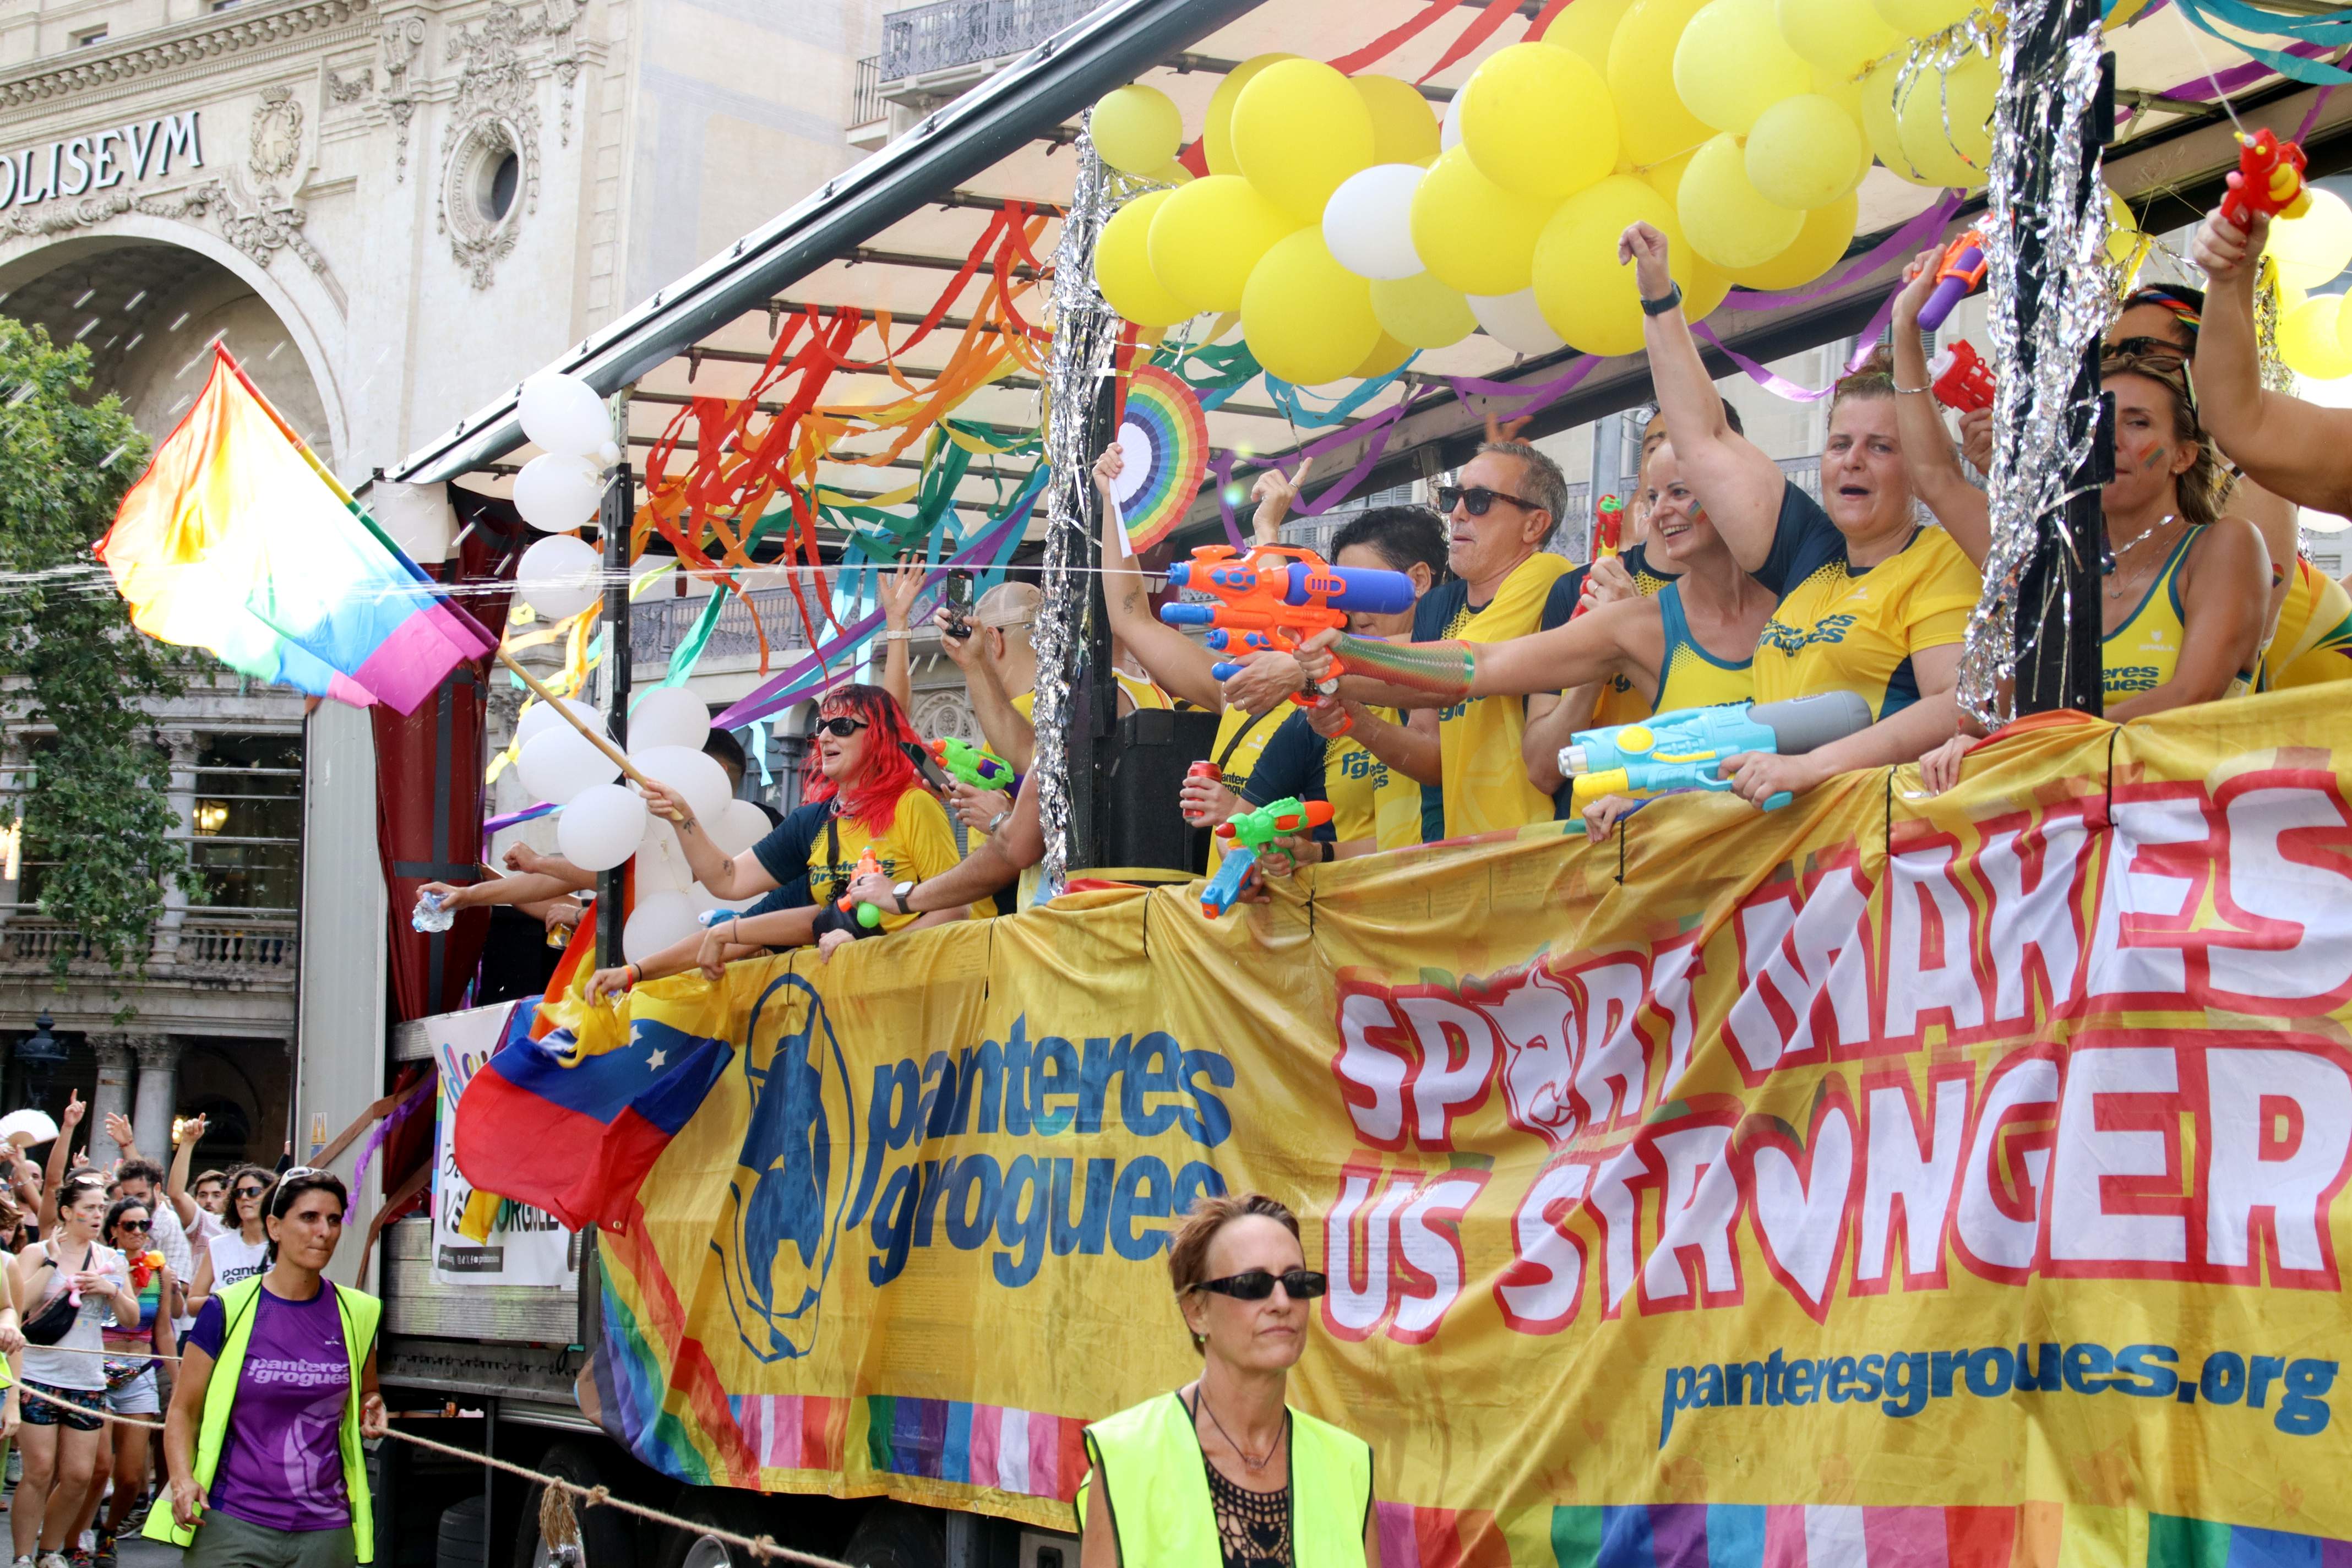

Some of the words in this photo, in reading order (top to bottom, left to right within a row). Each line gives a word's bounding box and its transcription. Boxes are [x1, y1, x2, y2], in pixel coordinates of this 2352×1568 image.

[1721, 769, 2352, 1088] MAKES
[846, 1011, 1235, 1231] panteres
[1321, 1164, 1493, 1345] US
